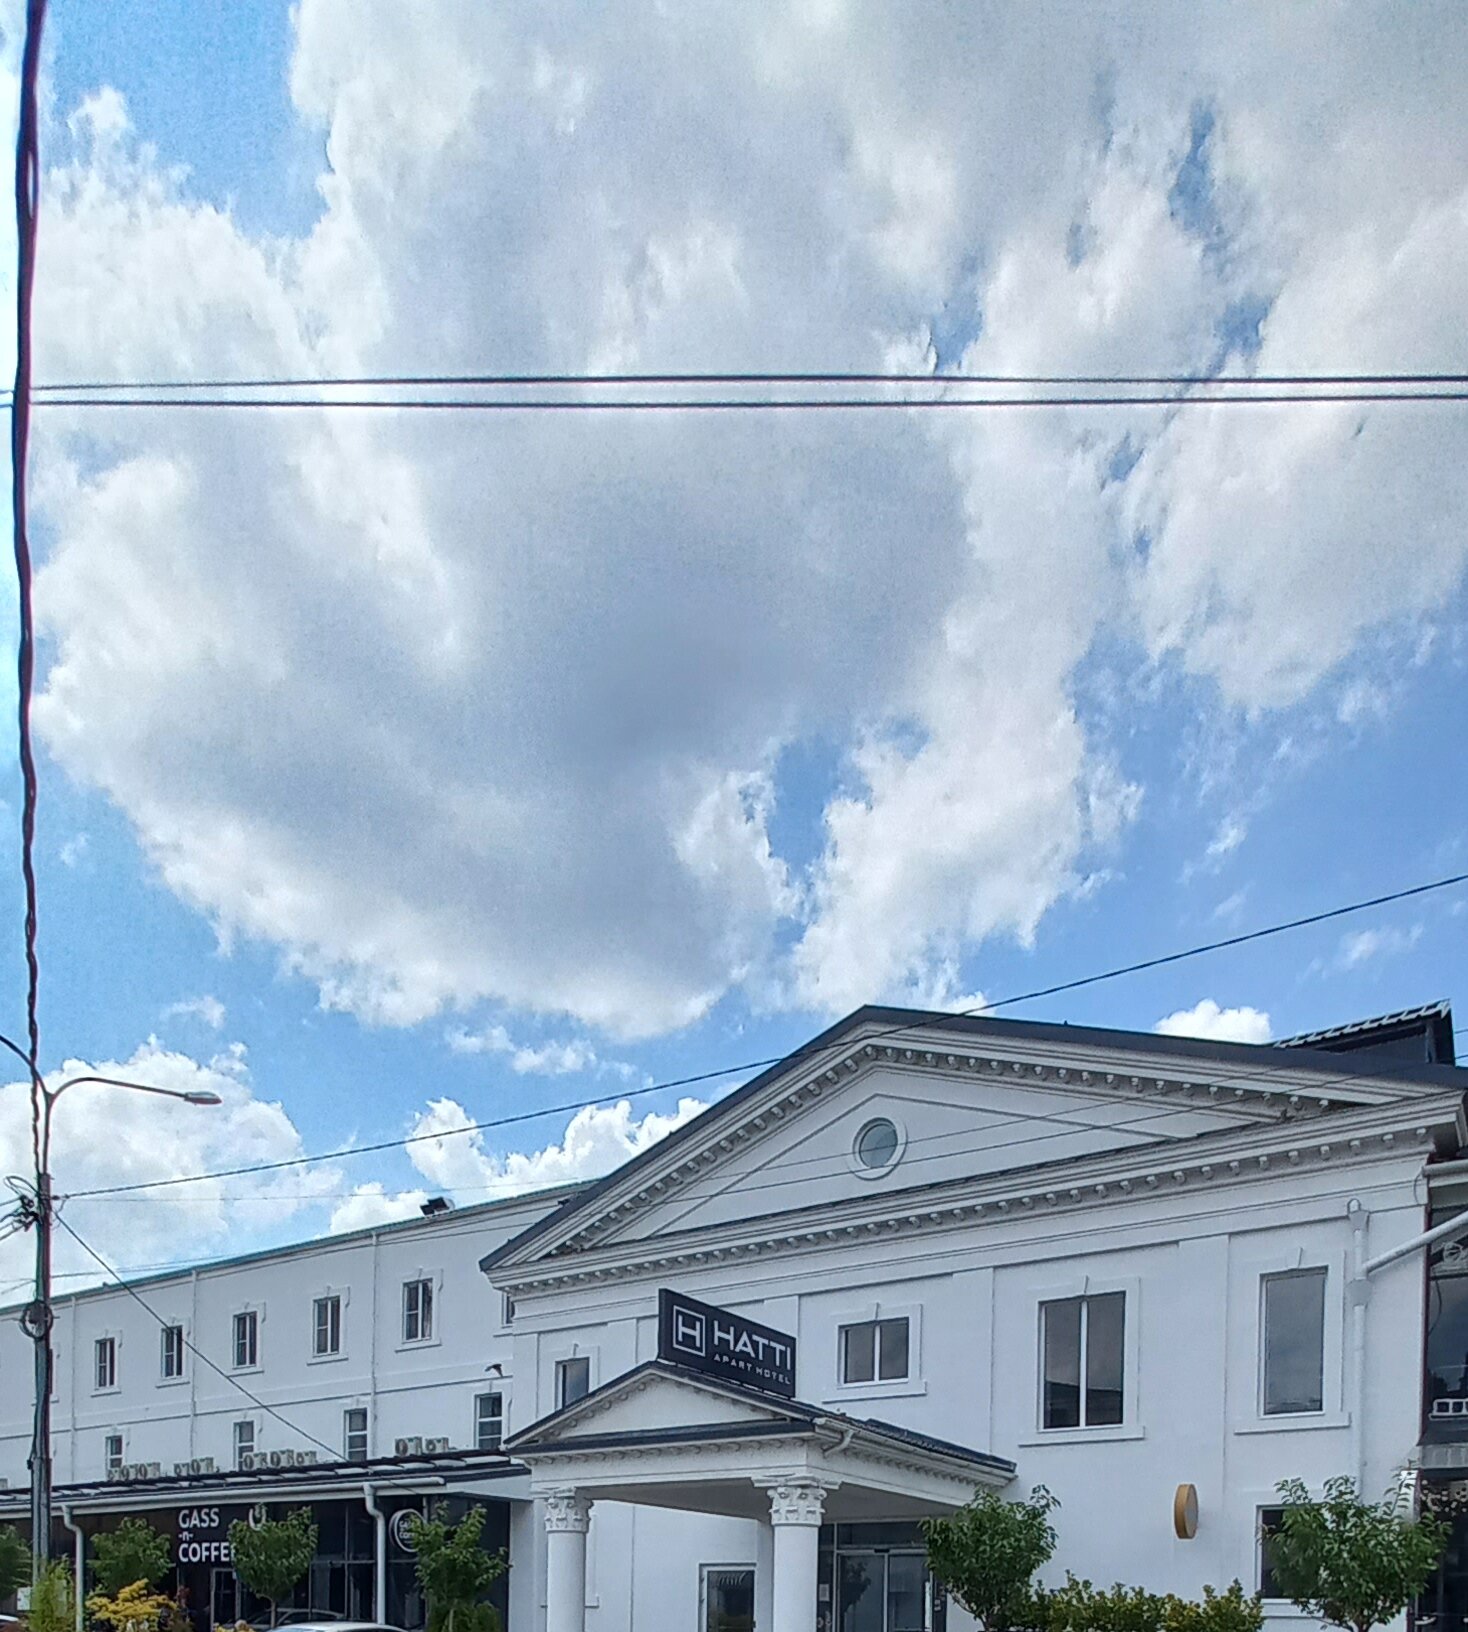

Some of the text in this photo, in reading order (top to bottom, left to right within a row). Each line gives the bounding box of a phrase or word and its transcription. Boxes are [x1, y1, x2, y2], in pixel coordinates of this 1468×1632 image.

[714, 1320, 791, 1370] HATTI
[714, 1354, 791, 1385] APART HOTEL
[178, 1508, 220, 1528] GASS
